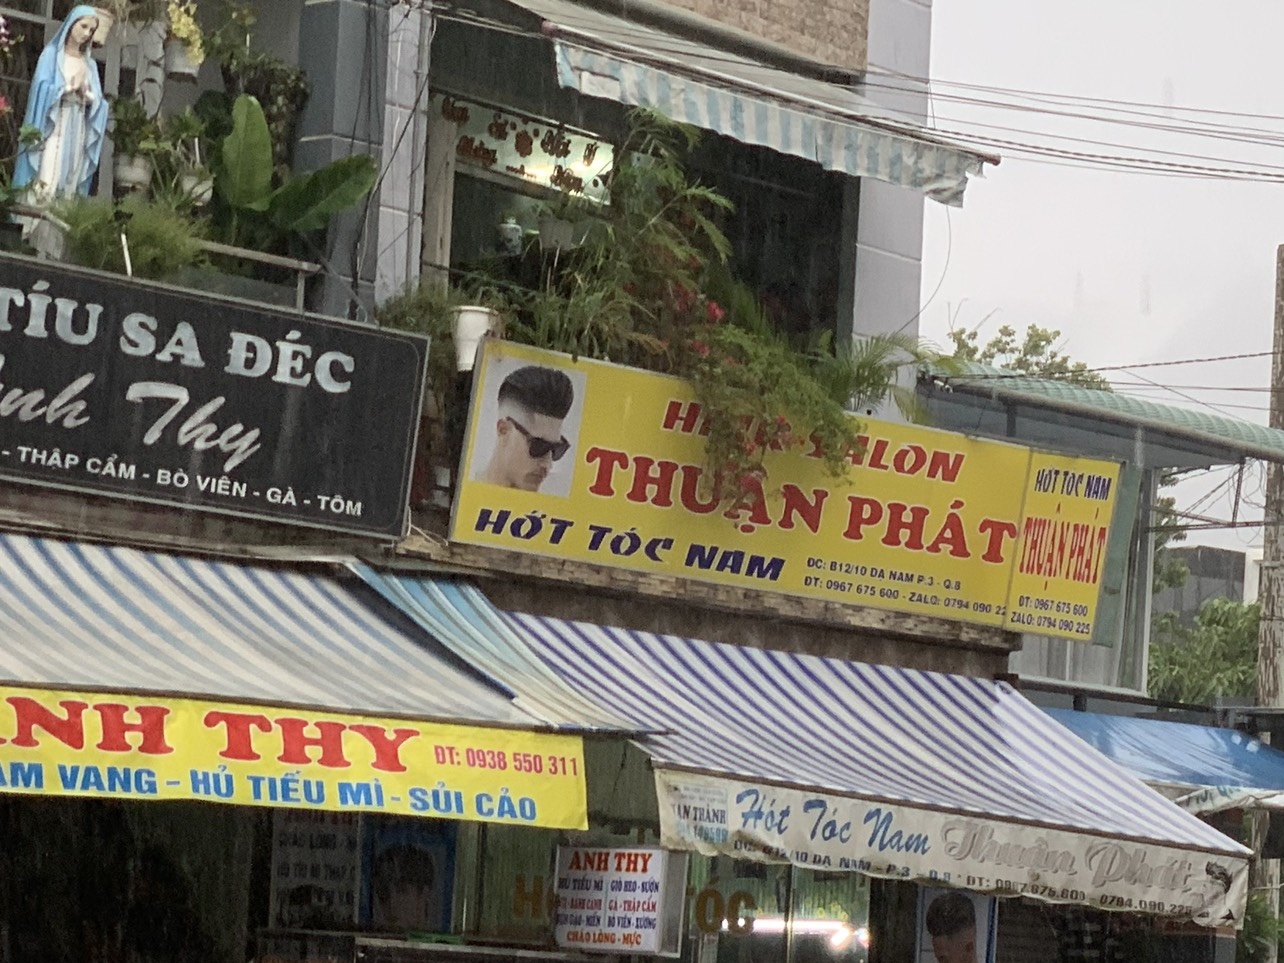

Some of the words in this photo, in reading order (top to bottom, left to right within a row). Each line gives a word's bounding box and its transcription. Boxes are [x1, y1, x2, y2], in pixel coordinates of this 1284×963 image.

[119, 312, 206, 368] SA
[126, 381, 262, 473] Thy
[16, 446, 80, 471] THẬP
[85, 453, 137, 480] CẨM
[155, 467, 190, 488] BÒ
[196, 474, 248, 498] VIÊN
[265, 484, 298, 507] GÀ
[316, 494, 363, 517] TÔM
[1084, 474, 1113, 501] NAM
[474, 508, 575, 546] HỚT
[587, 523, 675, 564] TÓC
[684, 542, 787, 582] NAM
[842, 496, 1019, 564] PHÁT
[825, 579, 853, 593] 0967
[856, 584, 877, 597] 675
[879, 588, 900, 601] 600
[829, 560, 868, 577] B12/10
[888, 570, 915, 584] NAM
[1034, 597, 1055, 612] 0967
[1055, 600, 1071, 615] 675
[1072, 604, 1088, 618] 600
[1075, 621, 1091, 635] 225
[0, 696, 175, 756] NH
[203, 710, 421, 774] THY
[433, 744, 462, 767] ĐT:
[465, 747, 508, 771] 0938
[512, 752, 544, 774] 550
[548, 757, 579, 776] 311
[57, 763, 158, 795] VANG
[189, 764, 235, 799] HỦ
[246, 768, 326, 805] TIẾU
[337, 777, 385, 807] MÌ
[408, 780, 465, 815] SỦI
[475, 786, 538, 821] CẢO
[863, 807, 931, 856] Nam
[568, 850, 610, 873] ANH
[613, 851, 653, 874] THY
[839, 856, 871, 871] NAM
